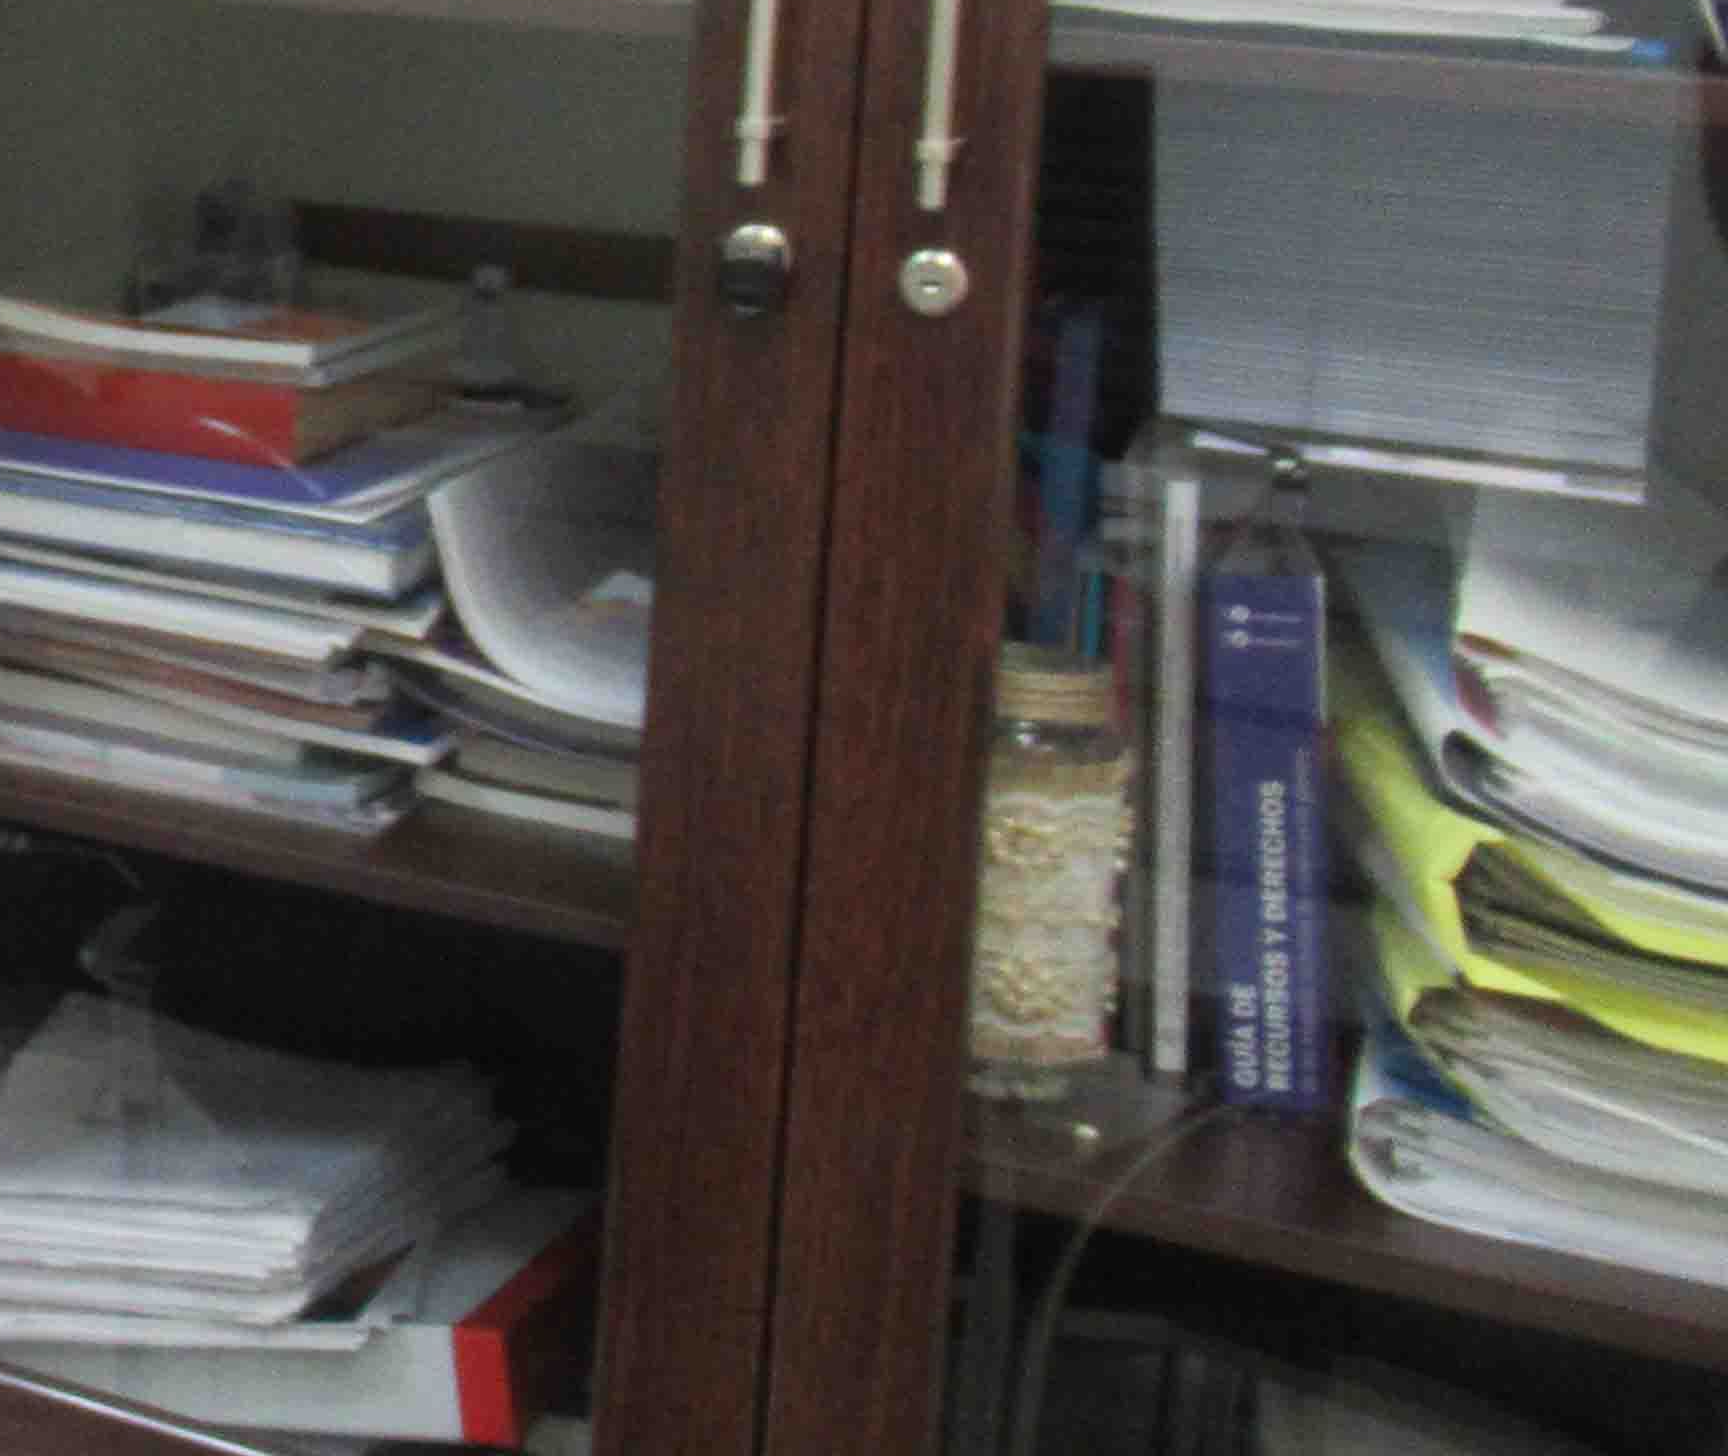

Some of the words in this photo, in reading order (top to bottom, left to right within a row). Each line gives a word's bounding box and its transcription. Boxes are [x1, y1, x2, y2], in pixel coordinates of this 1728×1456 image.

[1259, 780, 1288, 922] DERECHOS
[1262, 927, 1287, 944] Y
[1230, 983, 1257, 1019] DE
[1262, 951, 1292, 1092] RECURSOS
[1230, 1023, 1260, 1090] GUÍA
